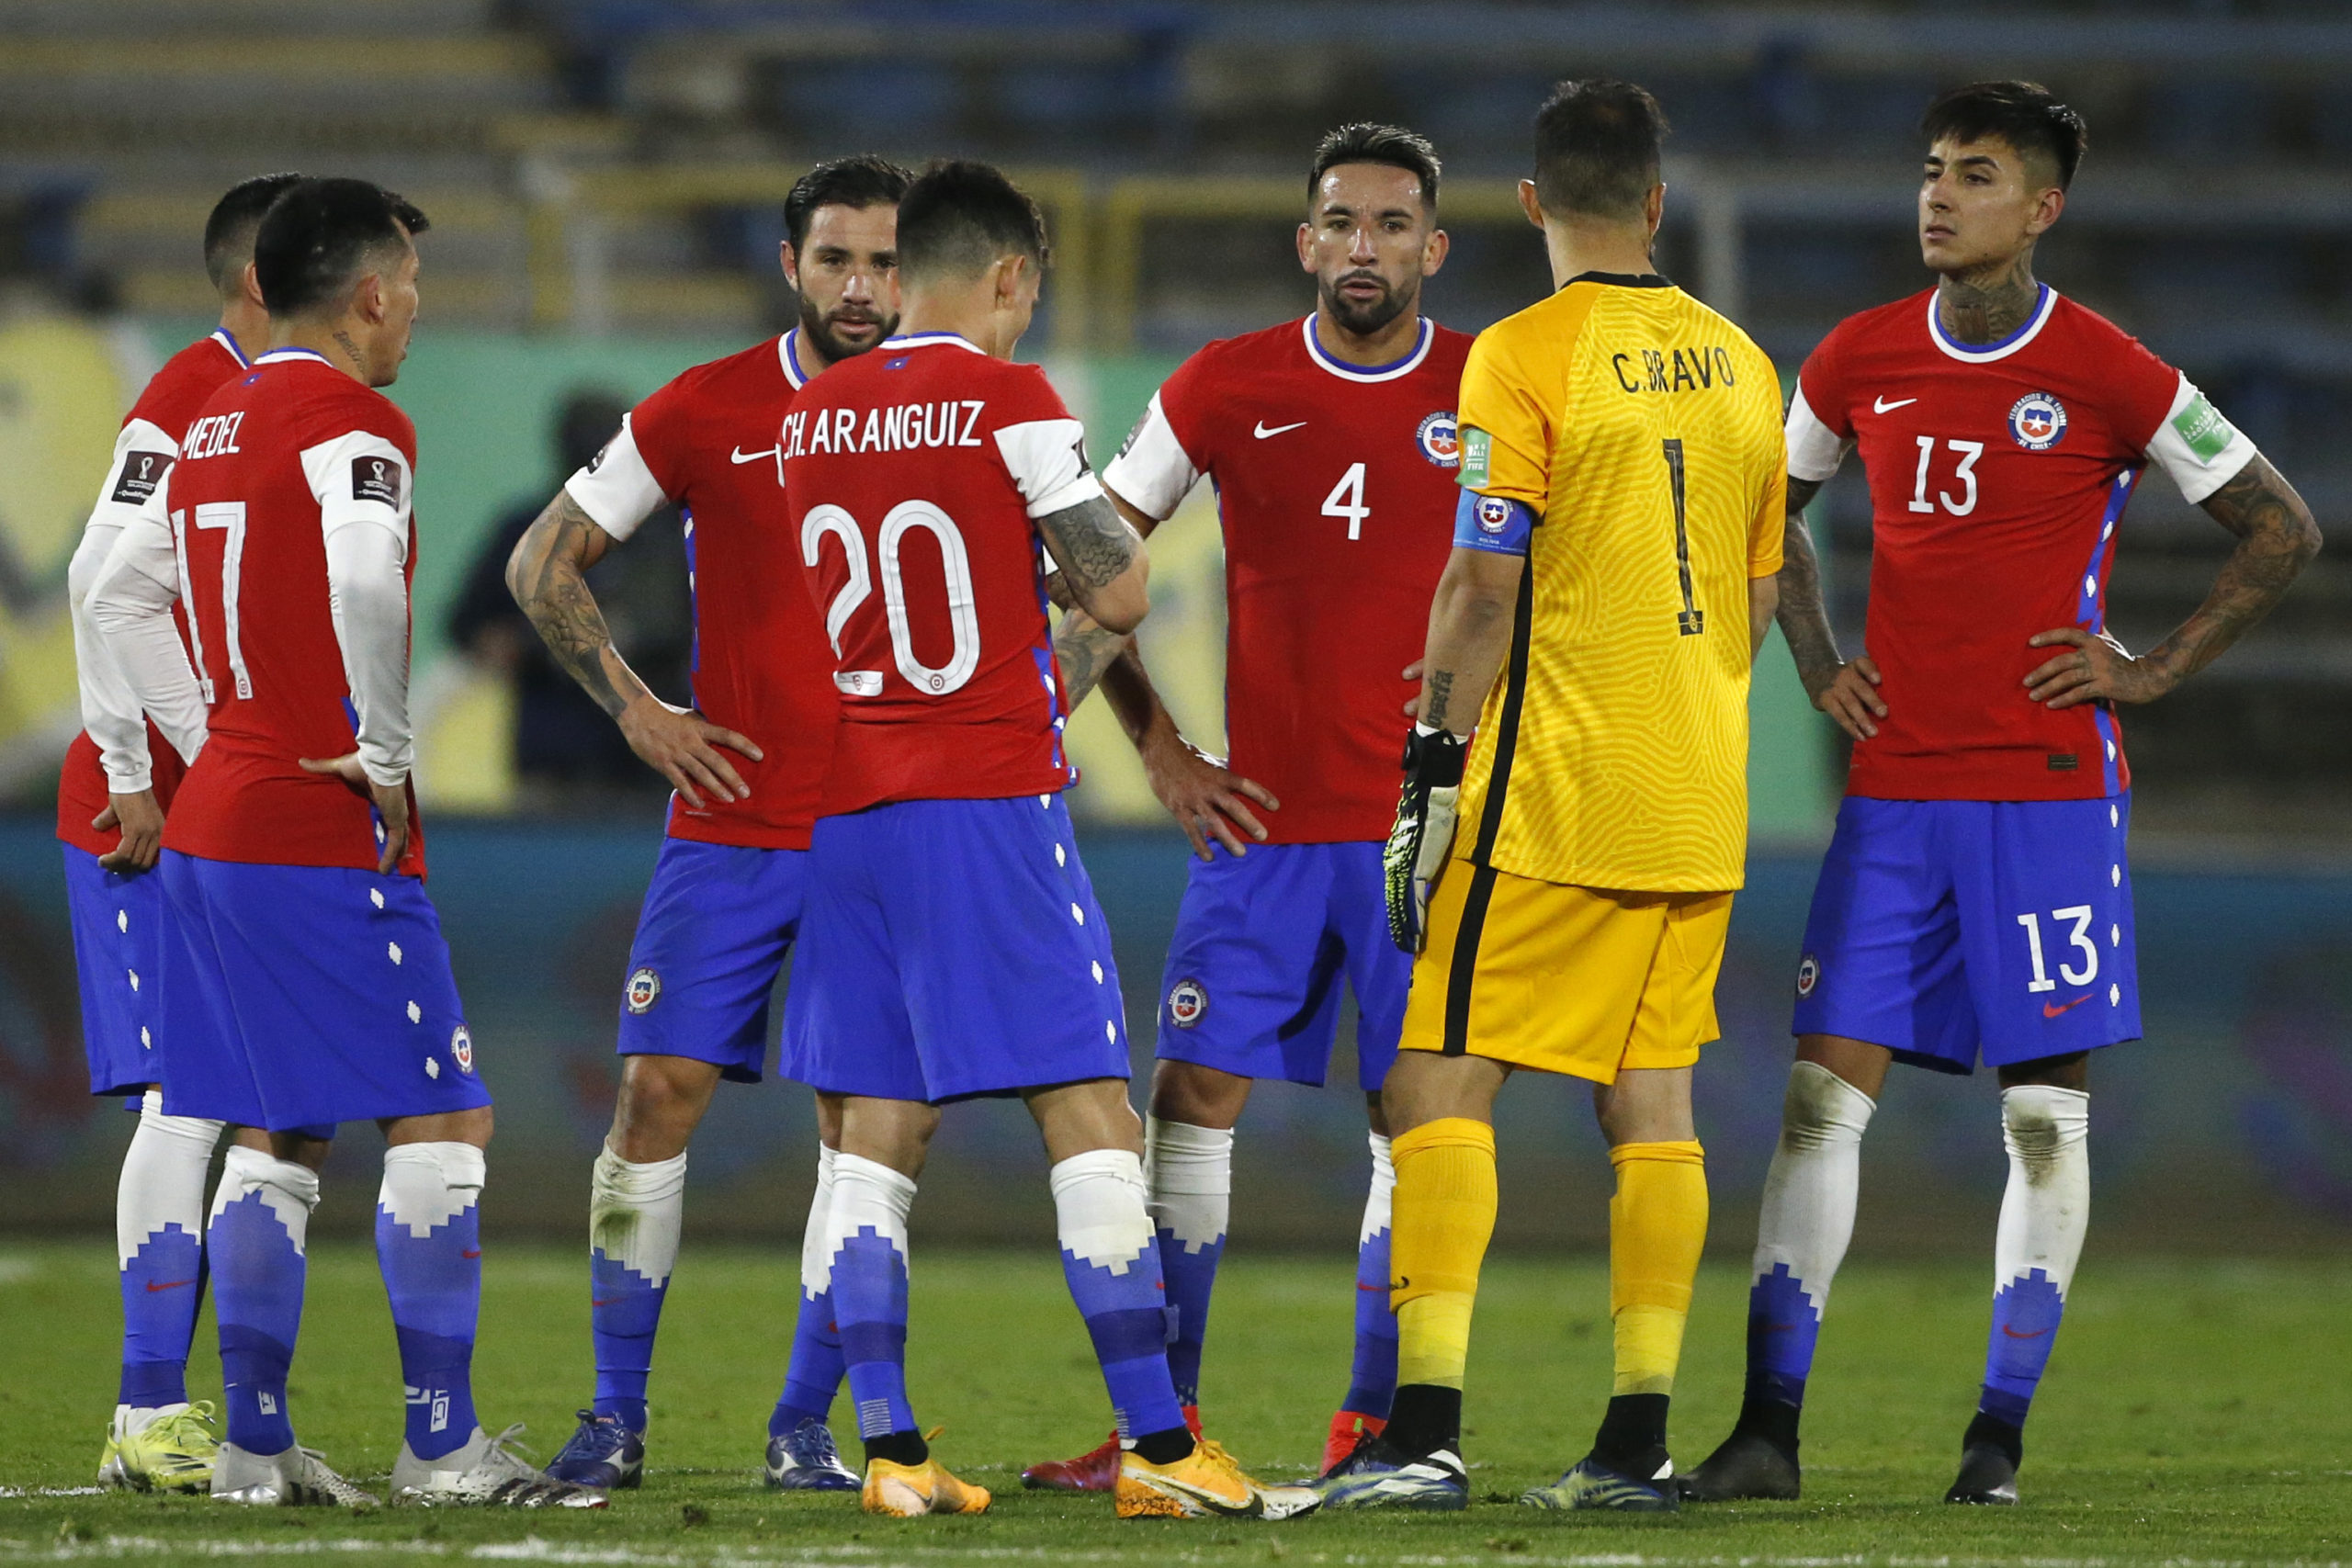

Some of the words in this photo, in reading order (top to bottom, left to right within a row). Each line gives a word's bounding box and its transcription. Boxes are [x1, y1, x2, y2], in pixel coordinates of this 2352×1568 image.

[177, 412, 245, 461] MEDEL
[1908, 435, 1984, 516] 13
[1320, 462, 1371, 540] 4
[1662, 438, 1703, 637] 1
[169, 501, 253, 704] 17
[800, 499, 980, 696] 20
[2017, 905, 2098, 993] 13
